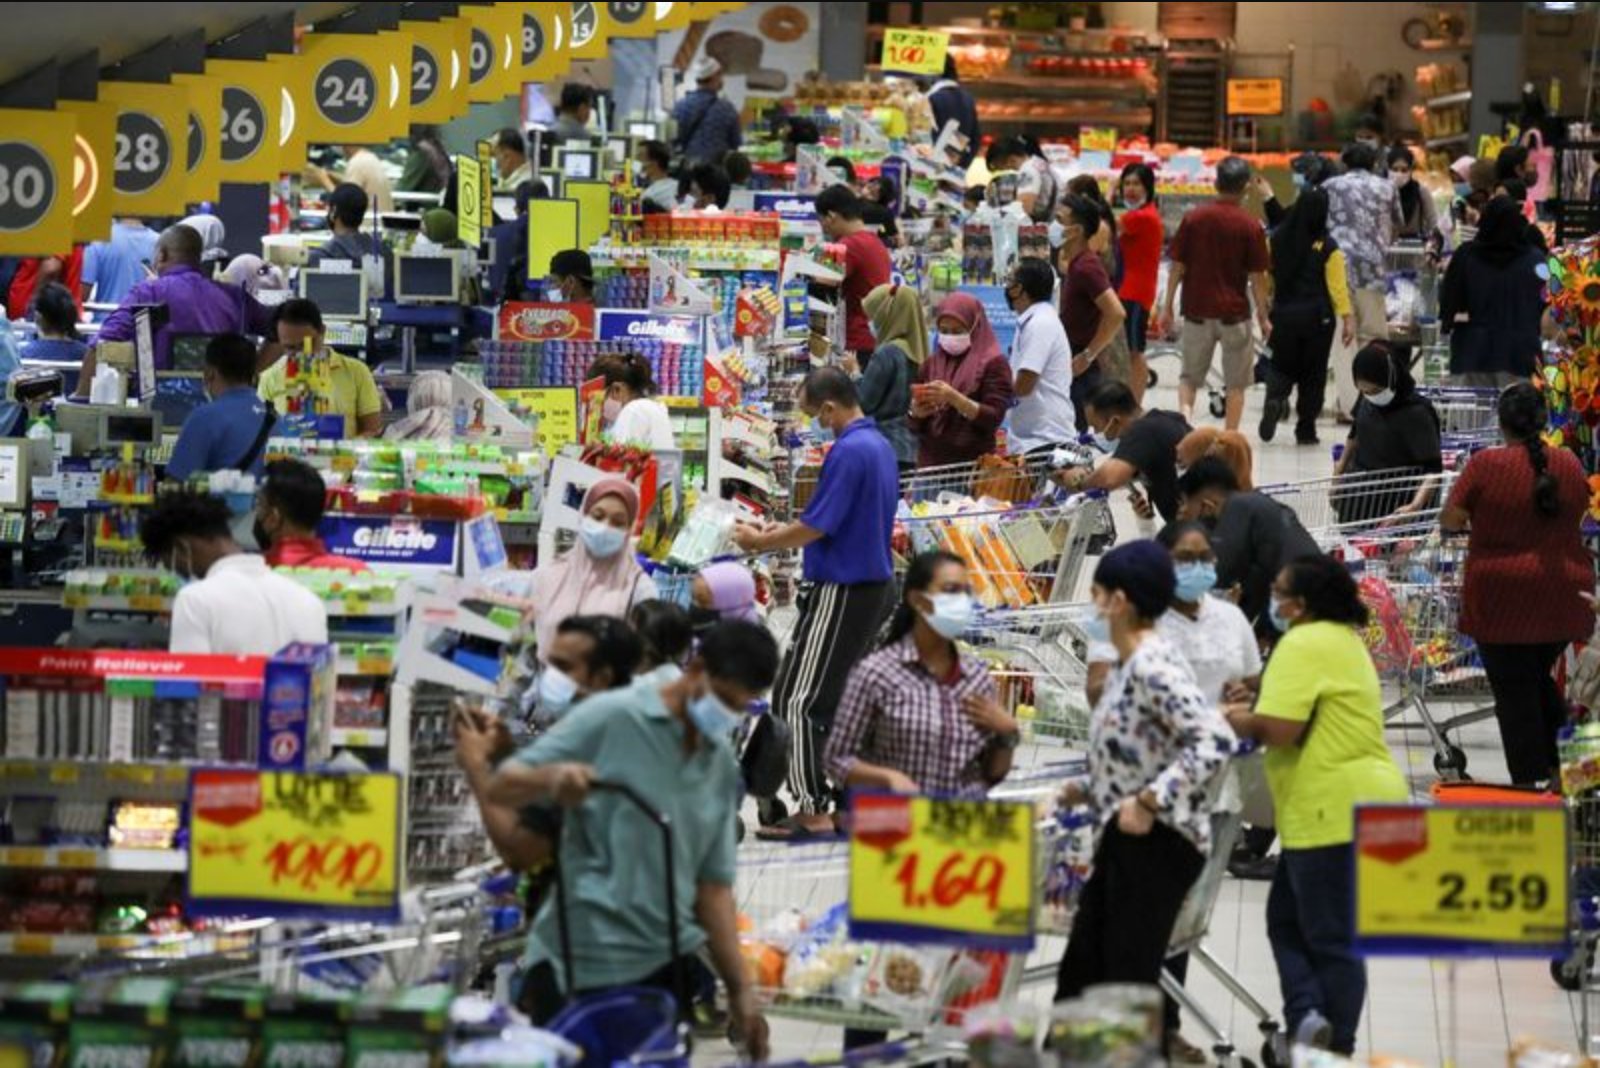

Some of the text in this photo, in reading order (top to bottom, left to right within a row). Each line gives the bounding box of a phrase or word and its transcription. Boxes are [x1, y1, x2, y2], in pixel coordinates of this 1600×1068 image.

[522, 27, 537, 53] 8
[573, 23, 590, 38] 15
[469, 42, 488, 70] 0
[413, 61, 432, 89] 2
[322, 76, 368, 107] 24
[40, 656, 88, 670] Pain
[897, 851, 1006, 911] 1.69
[1437, 871, 1549, 914] 2.59
